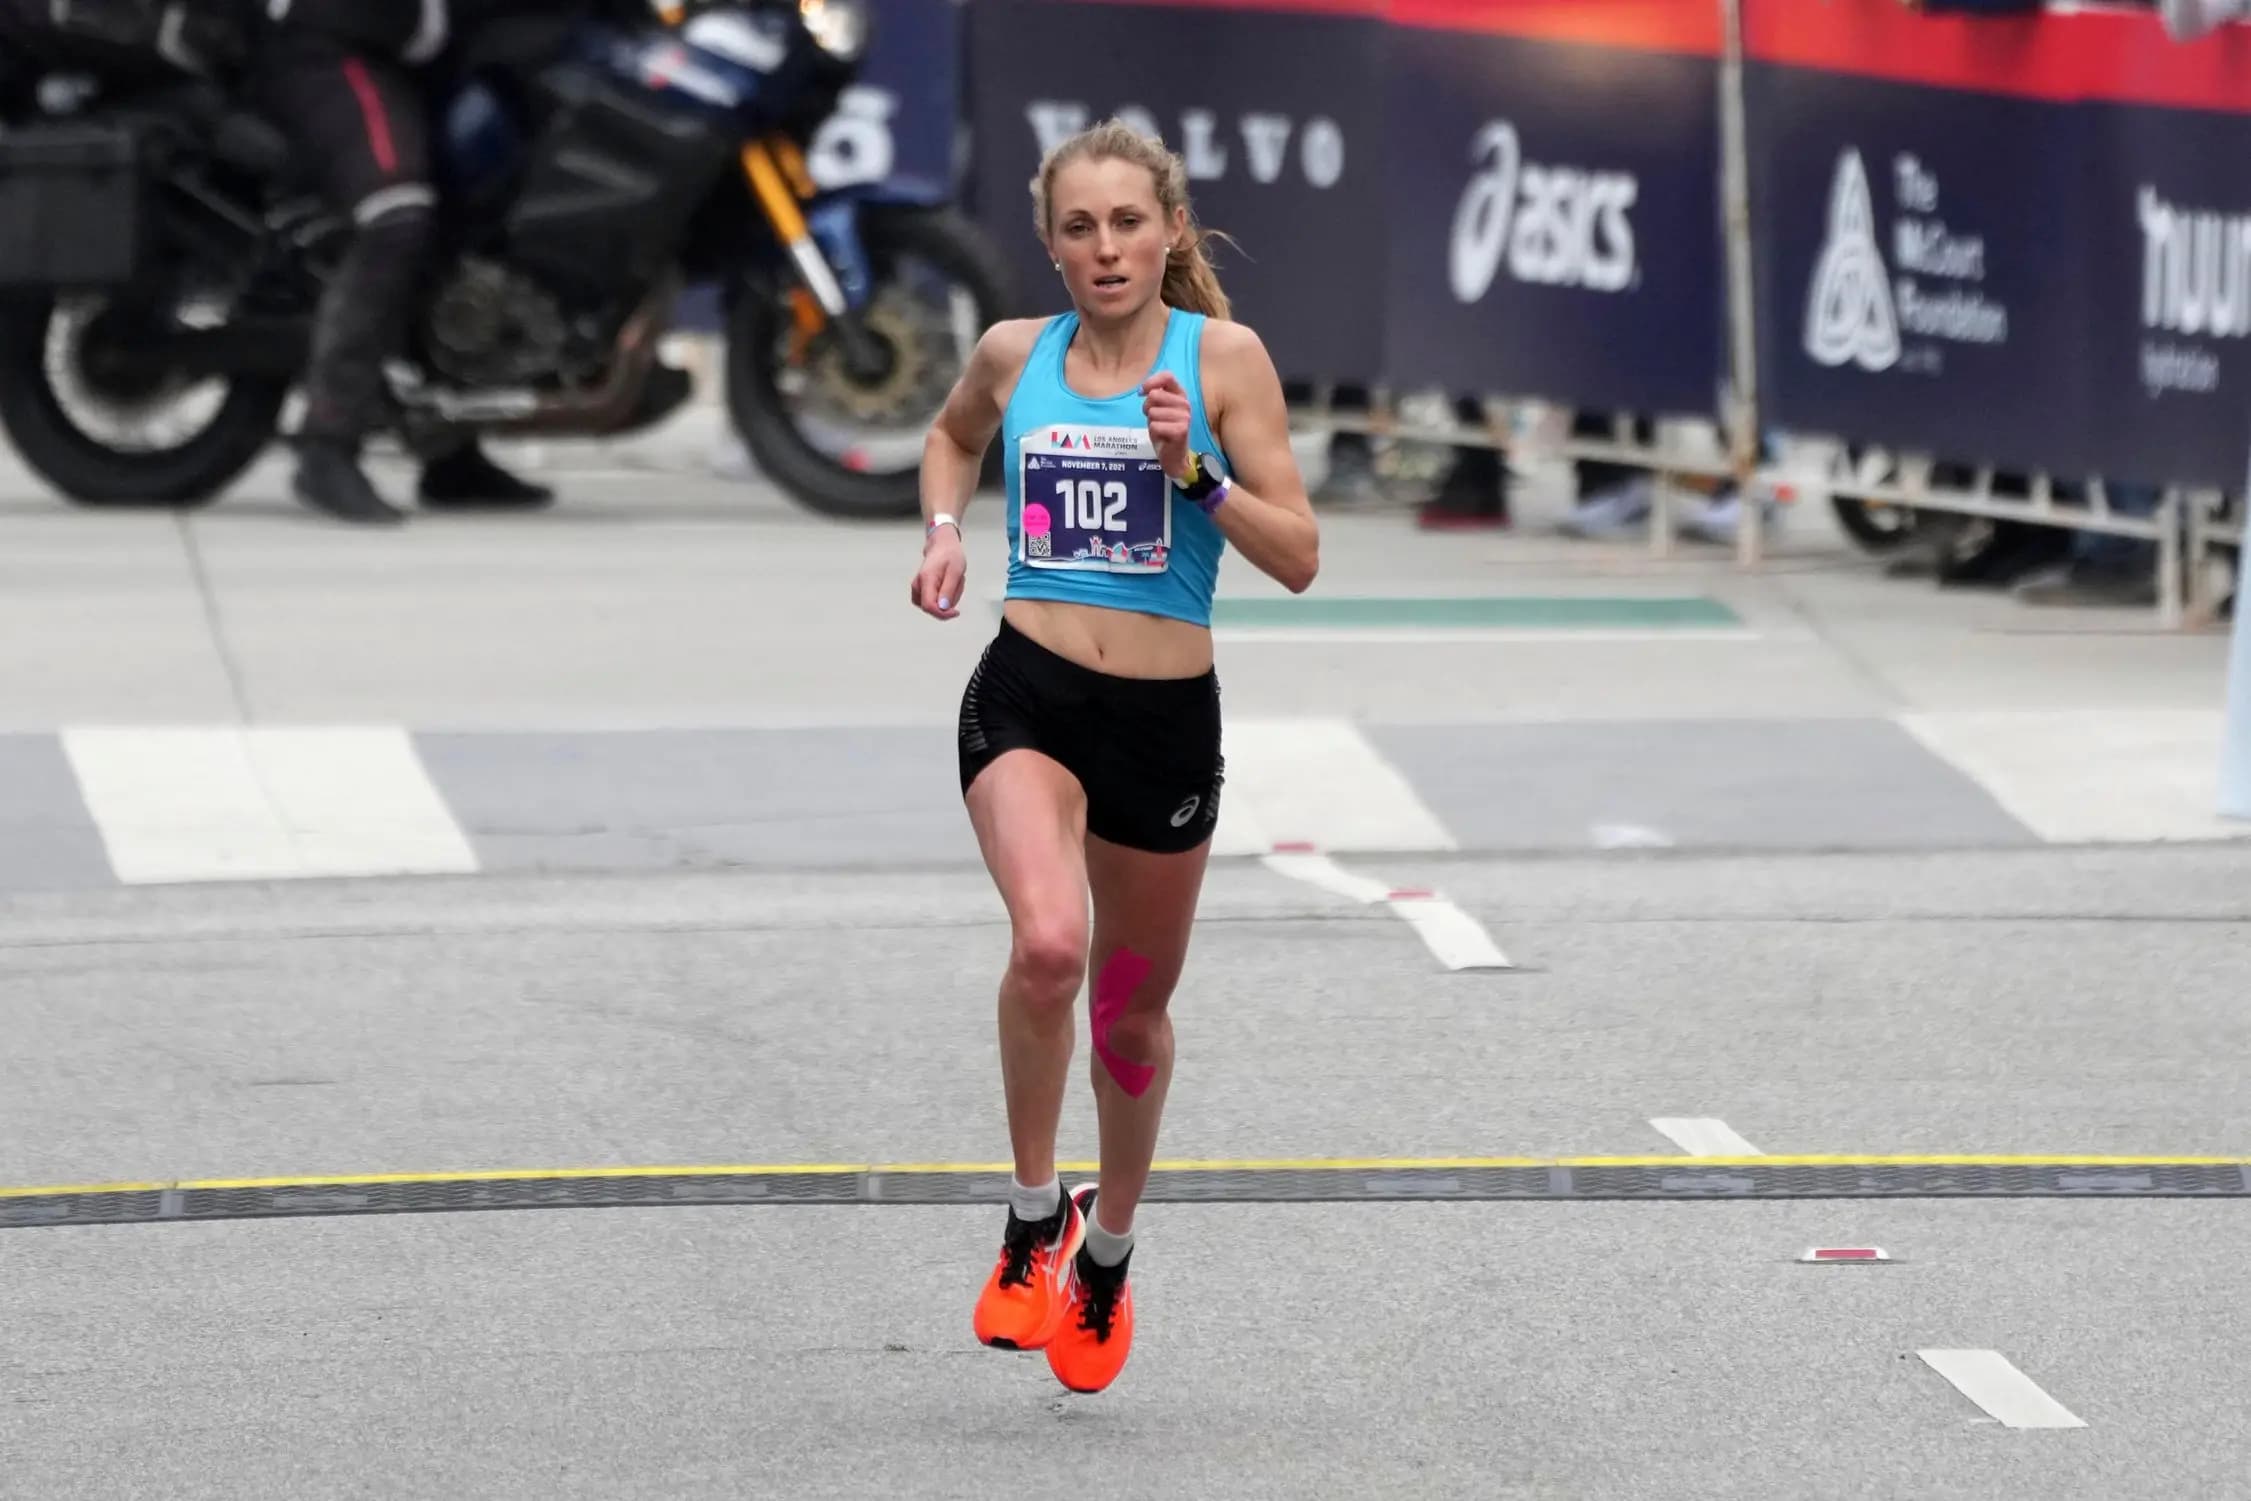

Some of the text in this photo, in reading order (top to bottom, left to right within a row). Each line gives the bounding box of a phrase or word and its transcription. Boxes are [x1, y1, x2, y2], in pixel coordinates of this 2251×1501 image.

[1094, 442, 1138, 450] MARATHON
[1062, 460, 1100, 471] NOVEMBER
[1108, 463, 1125, 471] 2021
[1056, 479, 1127, 531] 102
